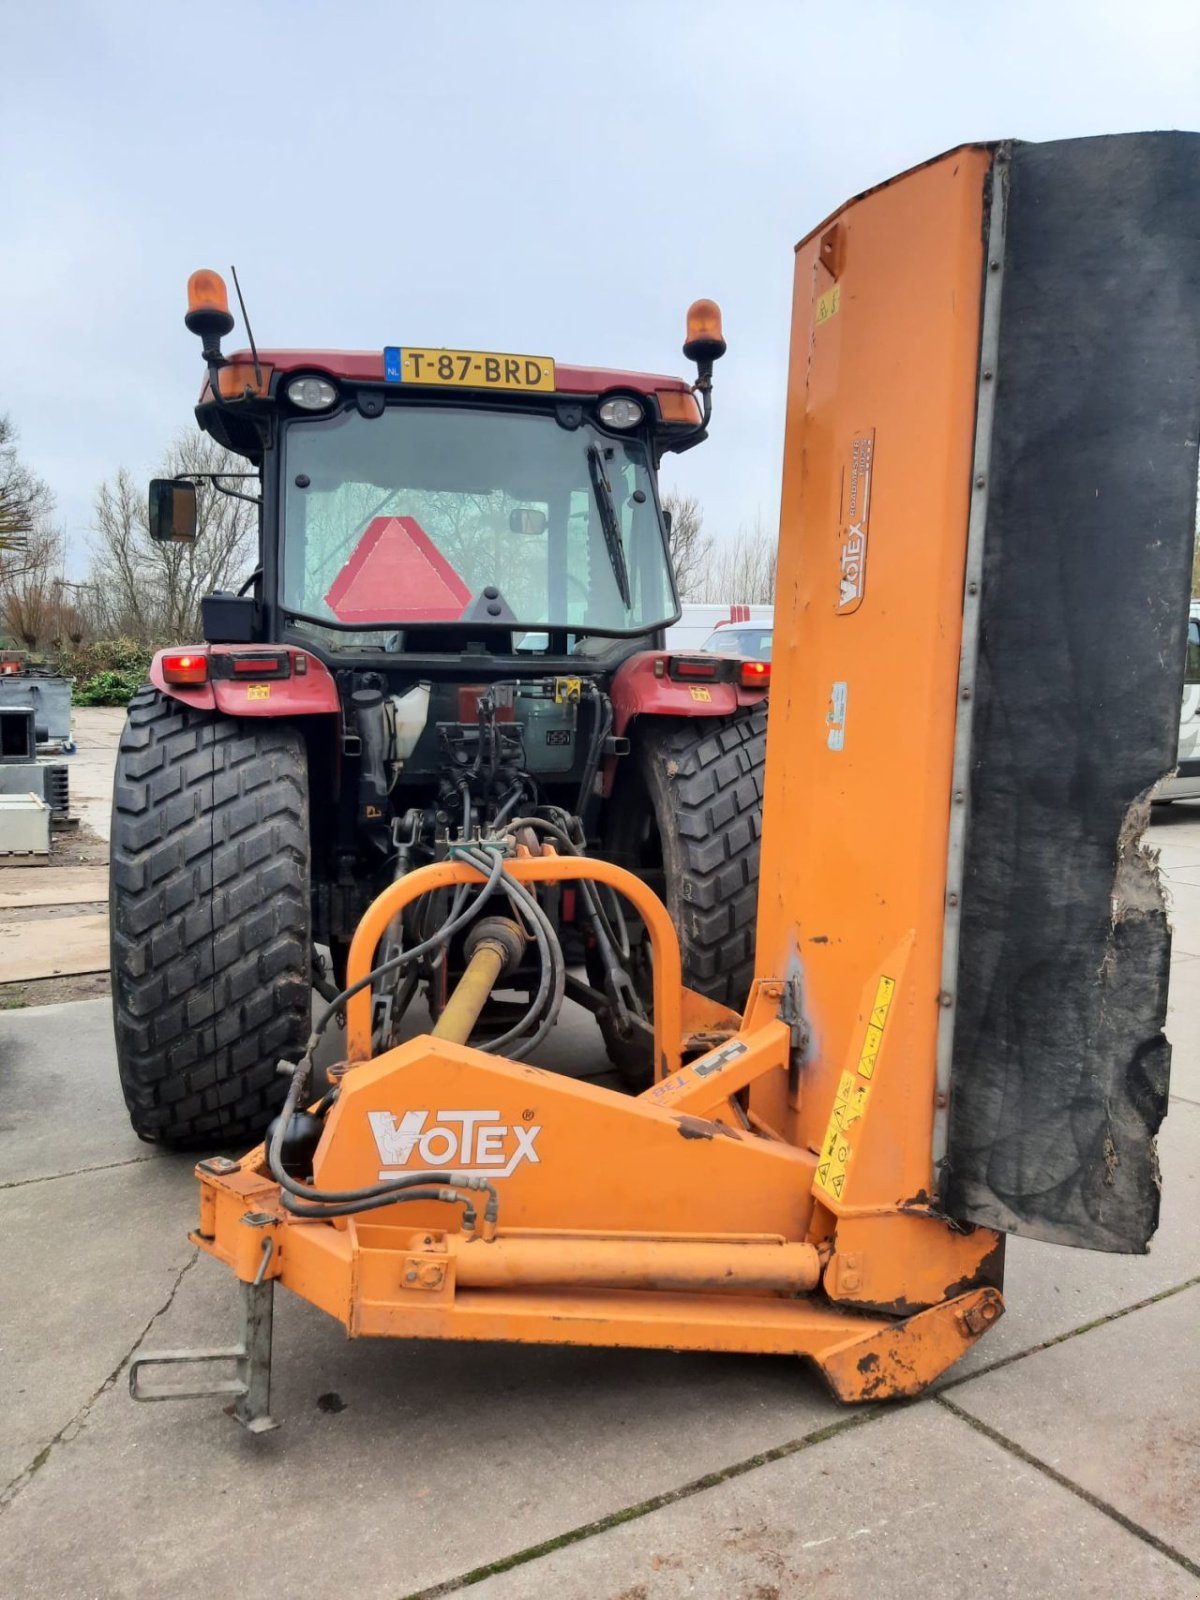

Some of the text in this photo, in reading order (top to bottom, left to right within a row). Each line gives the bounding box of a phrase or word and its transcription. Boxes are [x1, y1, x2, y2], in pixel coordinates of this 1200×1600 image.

[387, 368, 399, 376] NL
[408, 353, 542, 385] T-87-BRD
[849, 440, 859, 517] ROADMASTER
[839, 521, 863, 608] VOTEX
[367, 1110, 541, 1166] VOTEX
